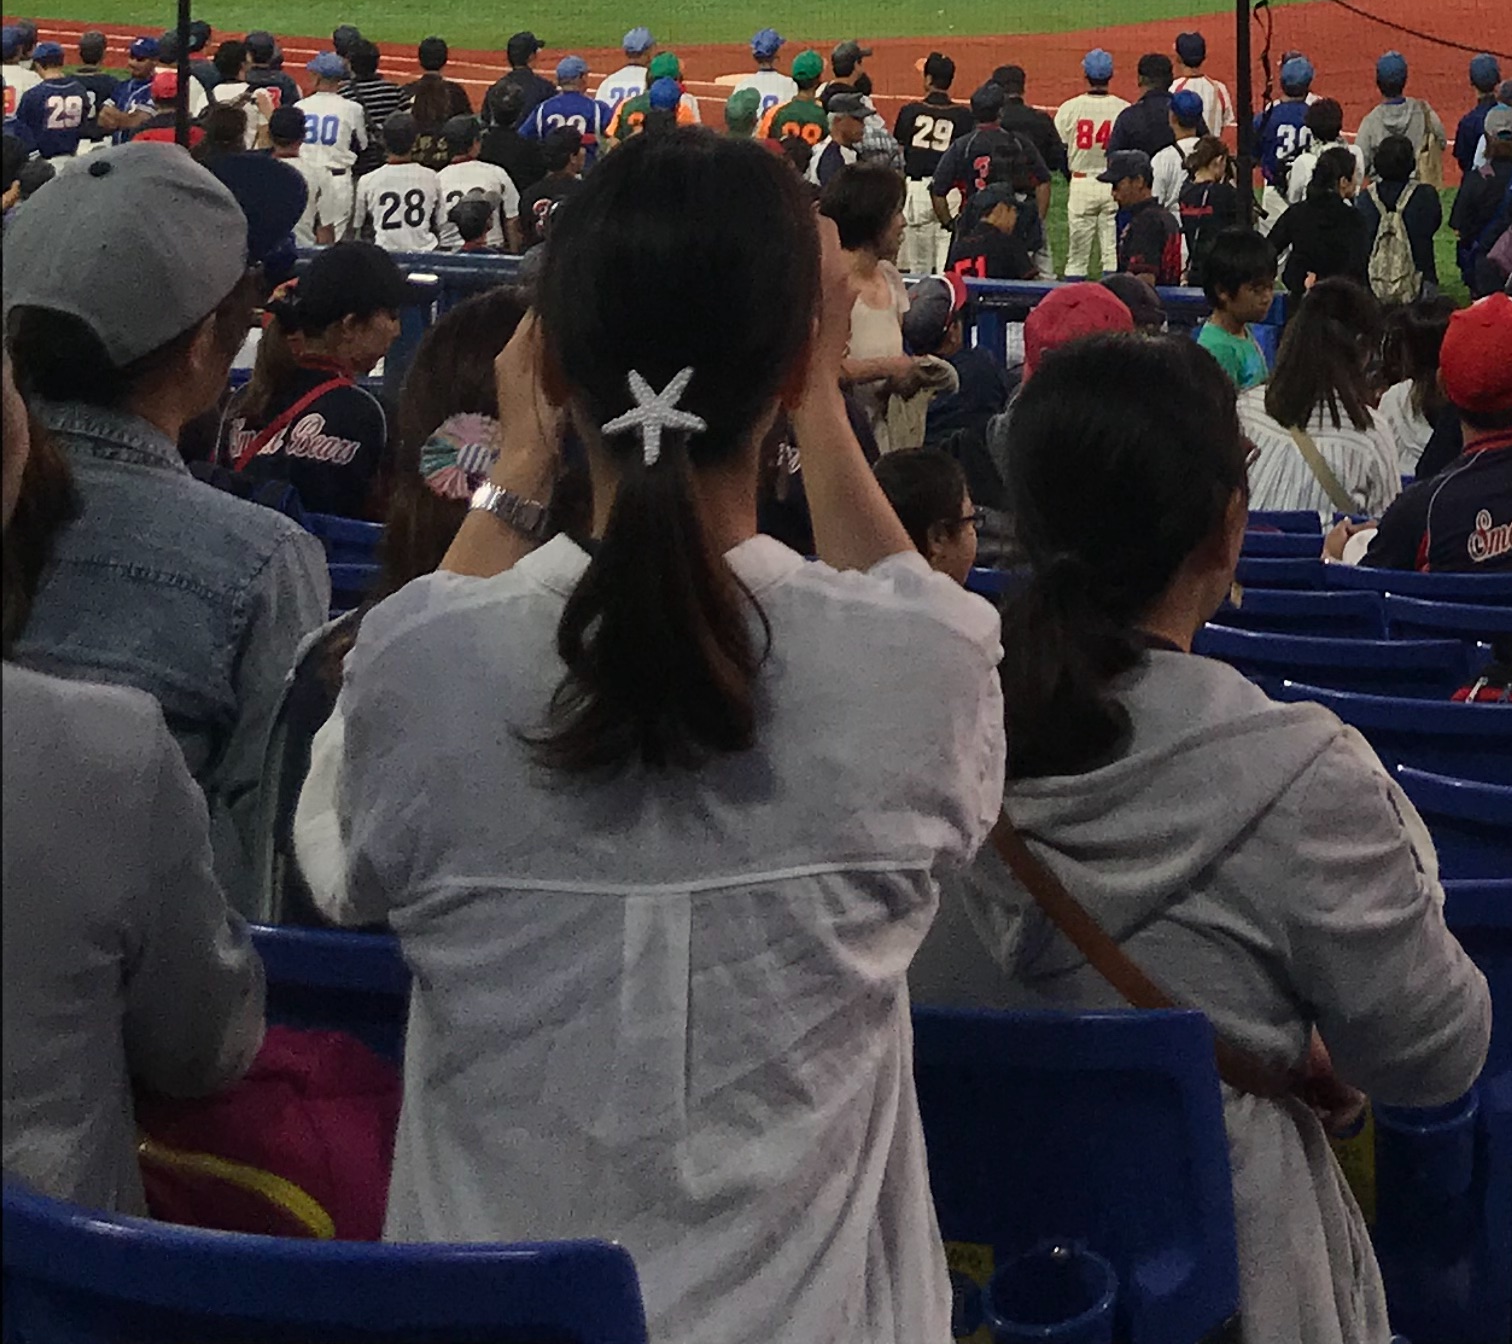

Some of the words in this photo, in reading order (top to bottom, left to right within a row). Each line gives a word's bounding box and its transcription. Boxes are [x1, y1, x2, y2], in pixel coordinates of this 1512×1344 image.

[46, 95, 84, 129] 29
[304, 114, 340, 146] 30
[912, 114, 954, 152] 29
[1075, 119, 1112, 150] 84
[379, 188, 426, 231] 28
[285, 412, 362, 465] Bears
